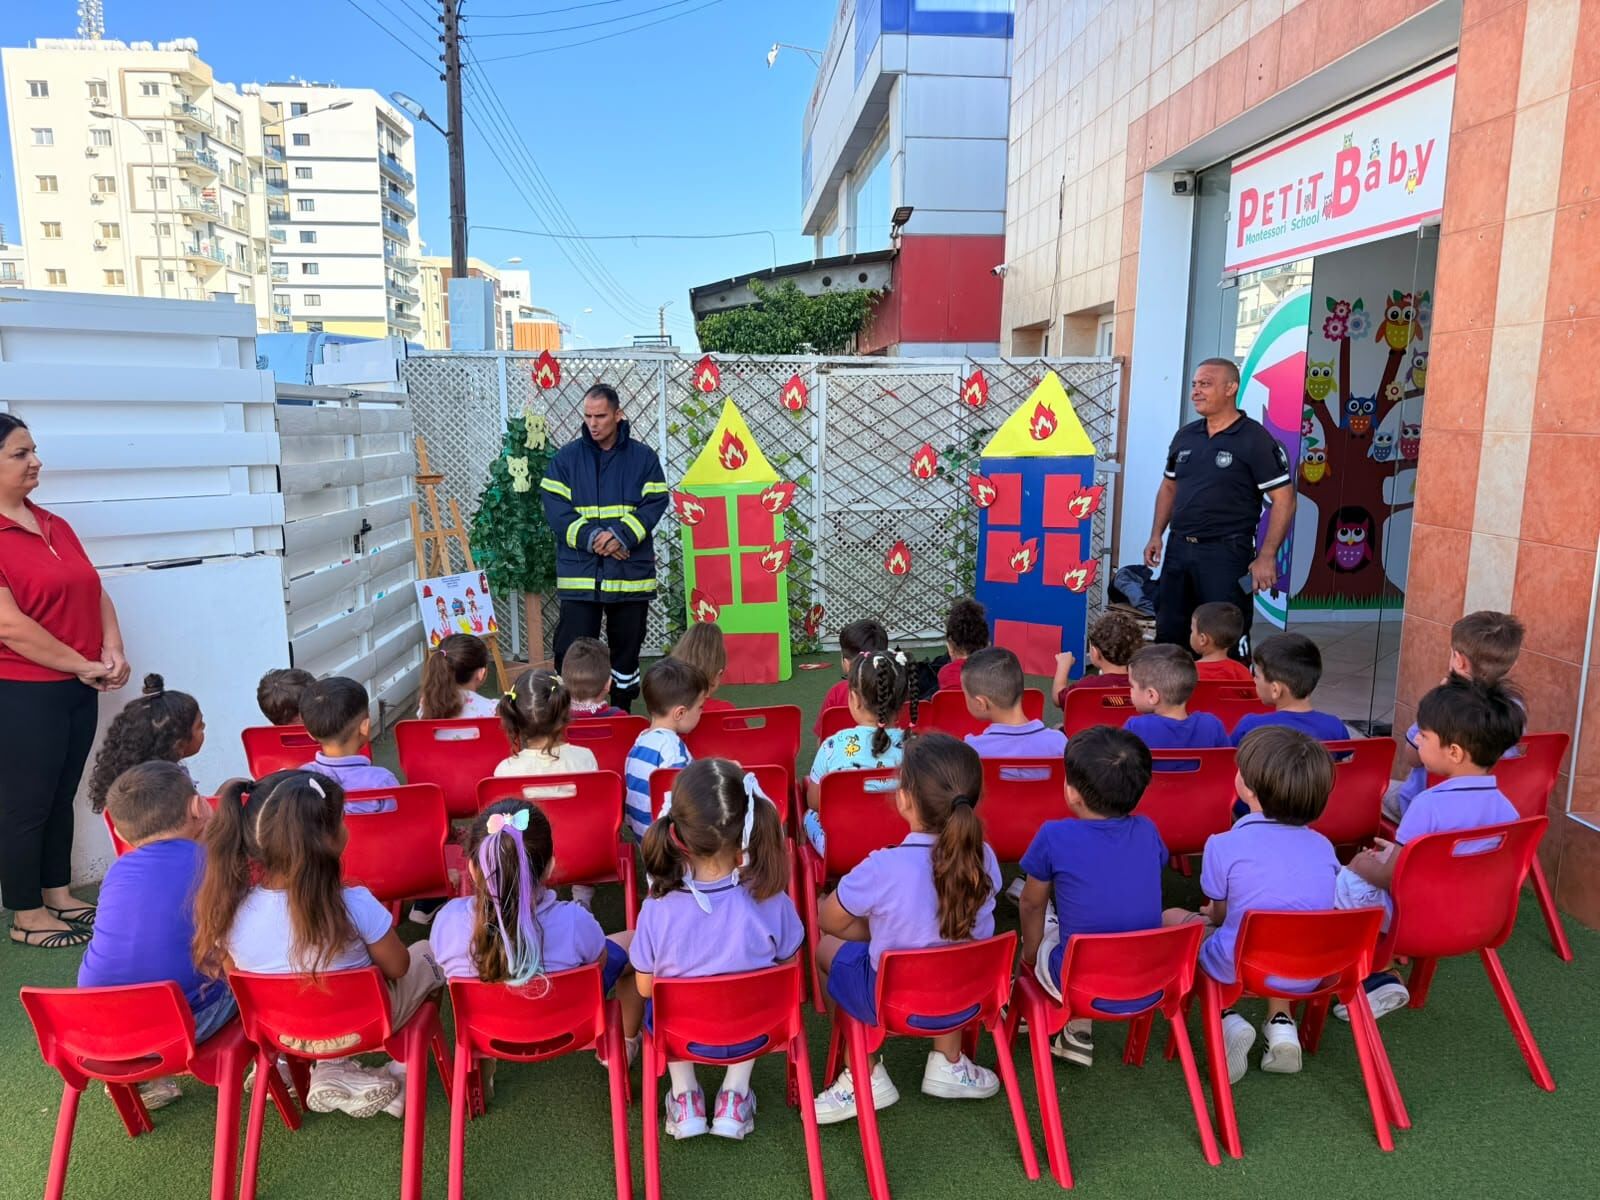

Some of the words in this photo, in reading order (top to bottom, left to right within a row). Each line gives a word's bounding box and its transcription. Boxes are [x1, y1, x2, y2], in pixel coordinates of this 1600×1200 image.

[1332, 138, 1435, 219] Baby
[1245, 220, 1287, 246] Montessori
[1291, 210, 1320, 232] School
